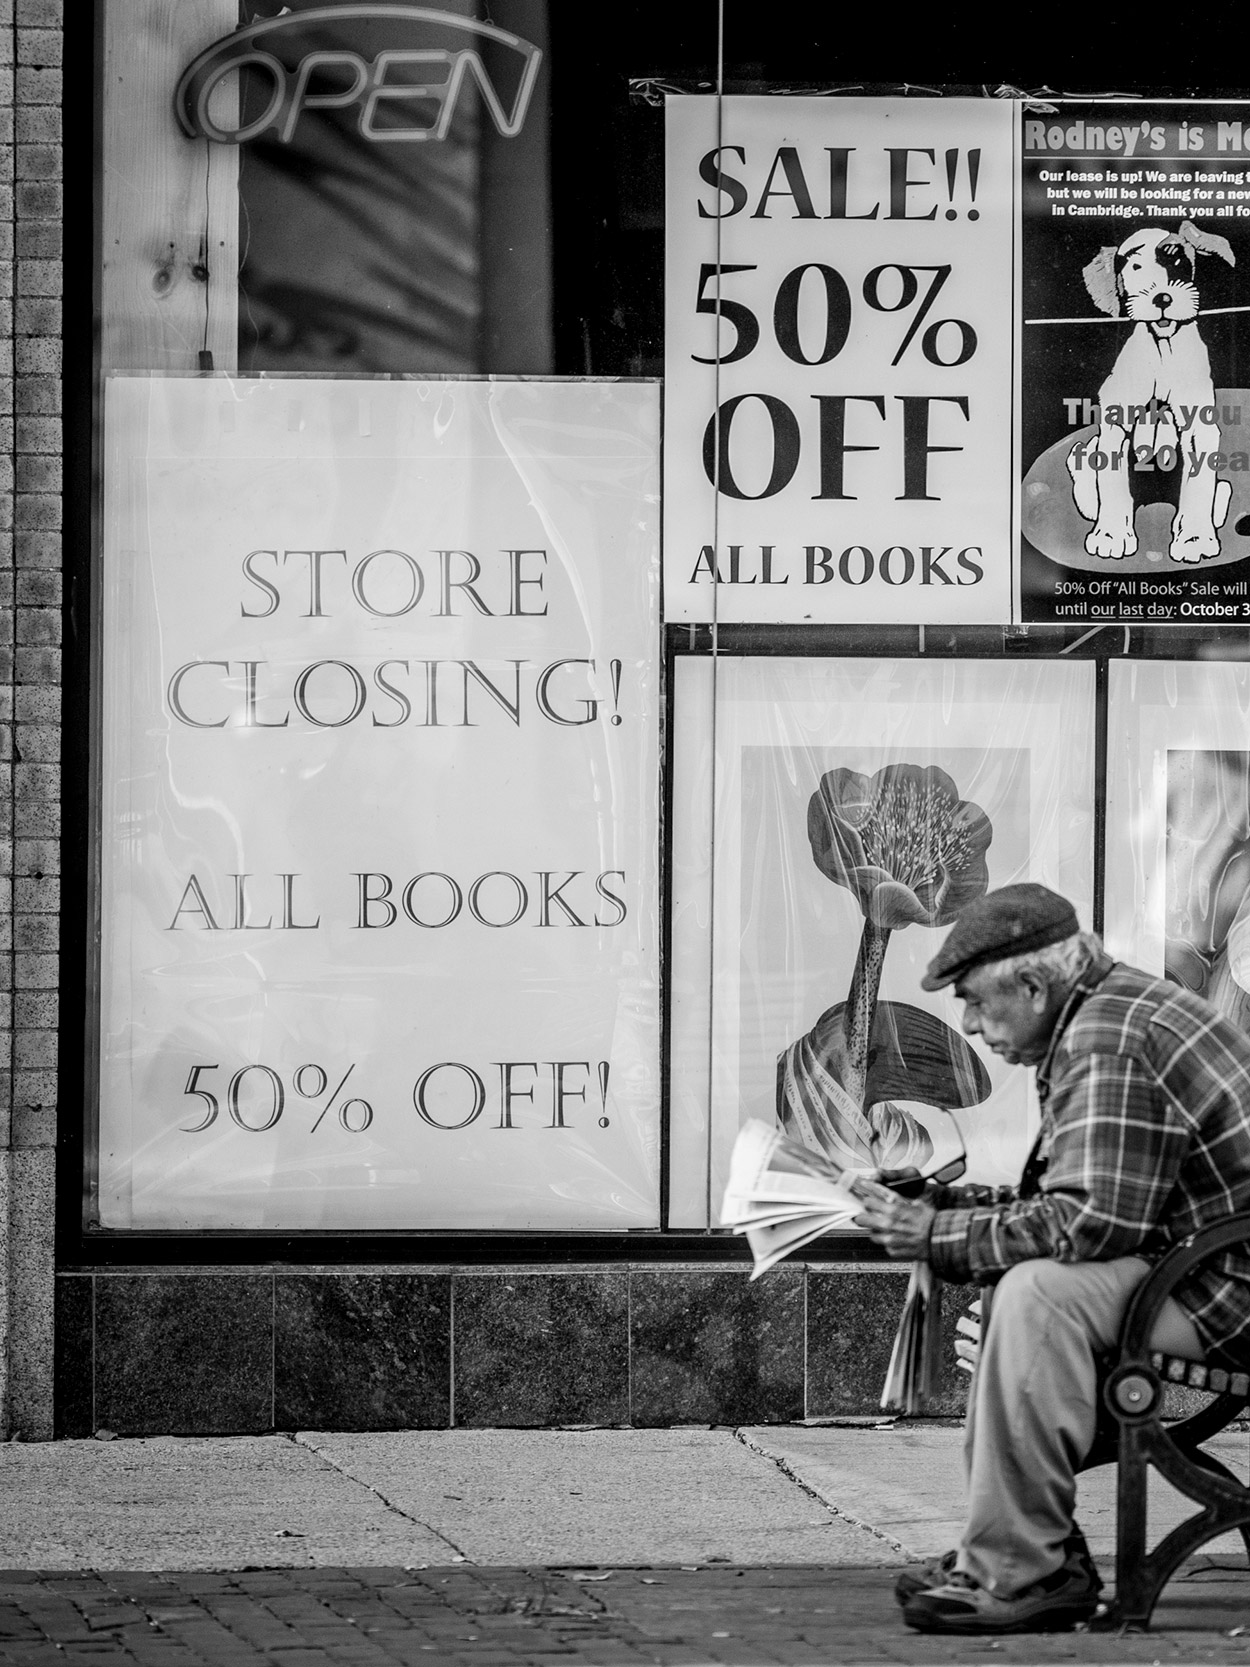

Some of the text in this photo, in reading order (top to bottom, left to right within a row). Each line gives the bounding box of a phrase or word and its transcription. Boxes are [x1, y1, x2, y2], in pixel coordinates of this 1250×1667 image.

[196, 48, 543, 145] OPEN
[1024, 121, 1166, 156] Rodney's
[1178, 121, 1205, 152] is
[697, 145, 982, 222] SALE!!
[1039, 170, 1064, 183] Our
[1066, 170, 1104, 183] lease
[1106, 170, 1118, 183] is
[1119, 170, 1143, 187] up!
[1145, 171, 1167, 184] We
[1169, 173, 1192, 184] are
[1194, 171, 1244, 186] leaving
[1047, 187, 1069, 200] but
[1072, 190, 1092, 200] we
[1094, 187, 1118, 200] will
[1120, 187, 1138, 200] be
[1140, 187, 1191, 203] looking
[1193, 188, 1214, 201] for
[1216, 191, 1225, 201] a
[1052, 204, 1065, 217] in
[1068, 204, 1144, 219] Cambridge.
[1146, 204, 1188, 217] Thank
[1189, 207, 1214, 220] you
[1216, 204, 1234, 217] all
[690, 262, 978, 368] 50%
[1062, 397, 1169, 426] Thank
[1179, 403, 1242, 432] you
[702, 392, 971, 502] OFF
[1072, 443, 1124, 472] for
[1133, 444, 1178, 473] 20
[239, 549, 548, 618] STORE
[688, 544, 985, 587] ALL BOOKS
[1054, 581, 1086, 596] 50%
[1089, 581, 1111, 595] Off
[1190, 581, 1220, 596] Sale
[1223, 581, 1248, 596] will
[1055, 602, 1088, 617] until
[1091, 605, 1116, 618] our
[1119, 602, 1144, 618] last
[1147, 602, 1177, 620] day:
[1180, 602, 1239, 617] October
[166, 657, 623, 729] CLOSING!
[164, 869, 629, 932] ALL BOOKS
[177, 1060, 613, 1135] 50% OFF!
